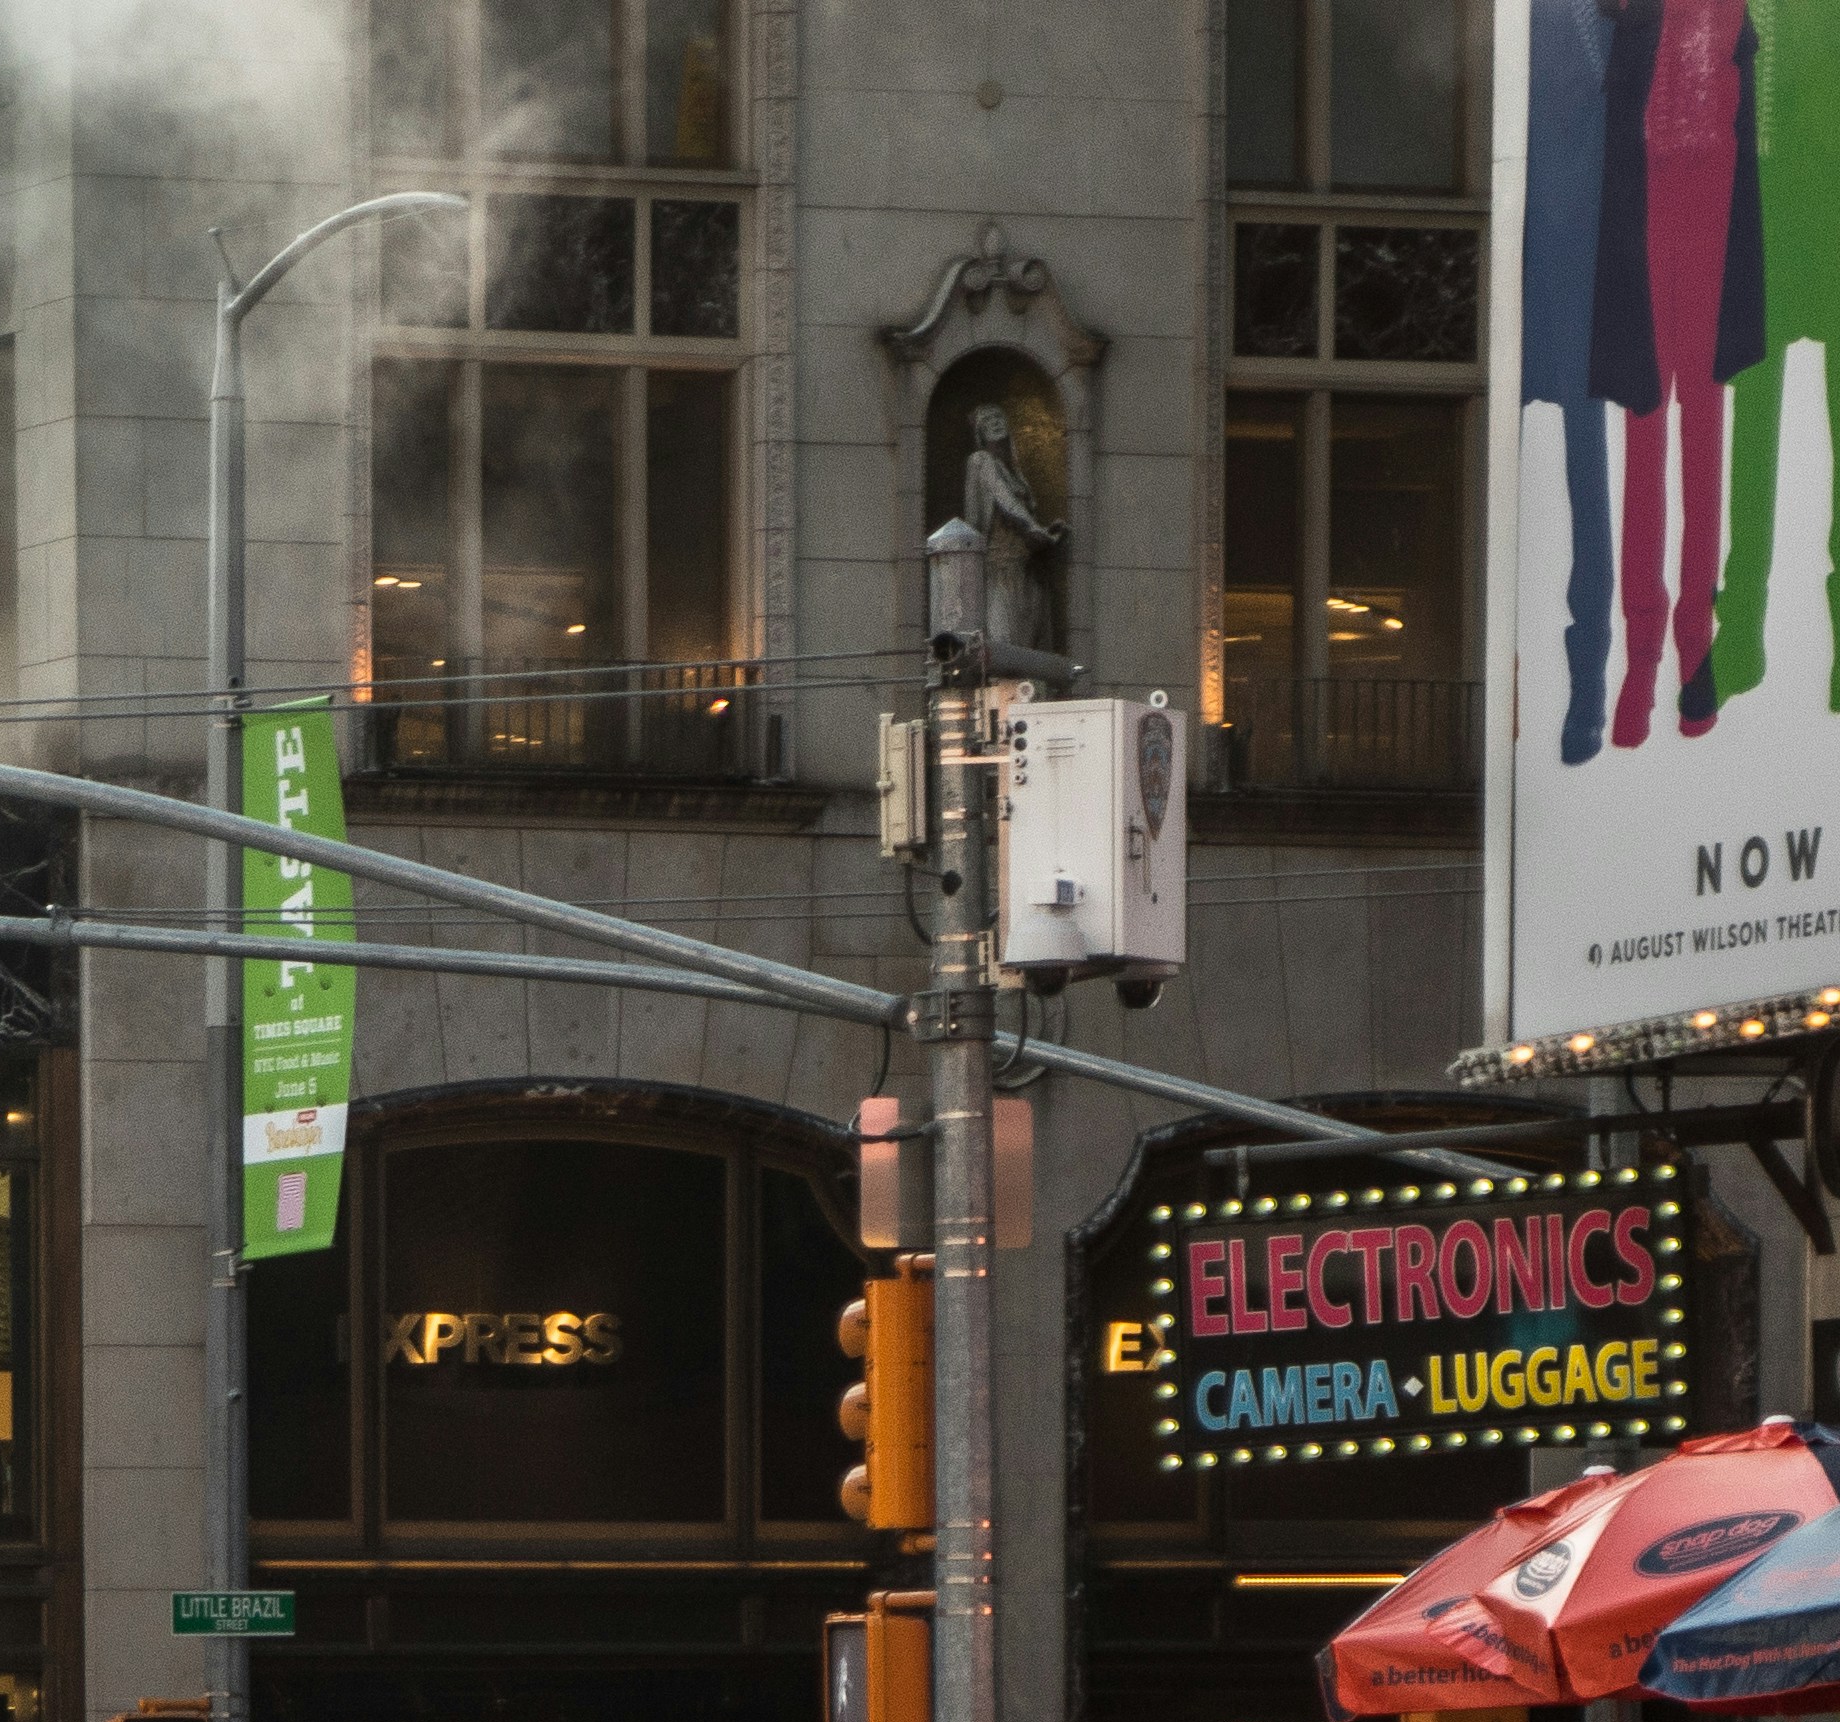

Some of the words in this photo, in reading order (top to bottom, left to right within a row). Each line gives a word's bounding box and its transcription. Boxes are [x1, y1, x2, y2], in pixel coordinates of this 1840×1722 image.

[1695, 826, 1824, 896] NOW
[1611, 931, 1685, 965] AUGUST
[1693, 920, 1767, 954] WILSON
[254, 1021, 291, 1040] TIMES
[293, 1014, 343, 1035] SQUARE
[1189, 1206, 1655, 1337] ELECTRONICS
[370, 1311, 622, 1366] XPRESS
[1196, 1359, 1400, 1431] CAMERA
[1430, 1339, 1659, 1414] LUGGAGE
[181, 1597, 227, 1618] LITTLE
[232, 1597, 285, 1618] BRAZIL
[215, 1618, 249, 1630] STREET
